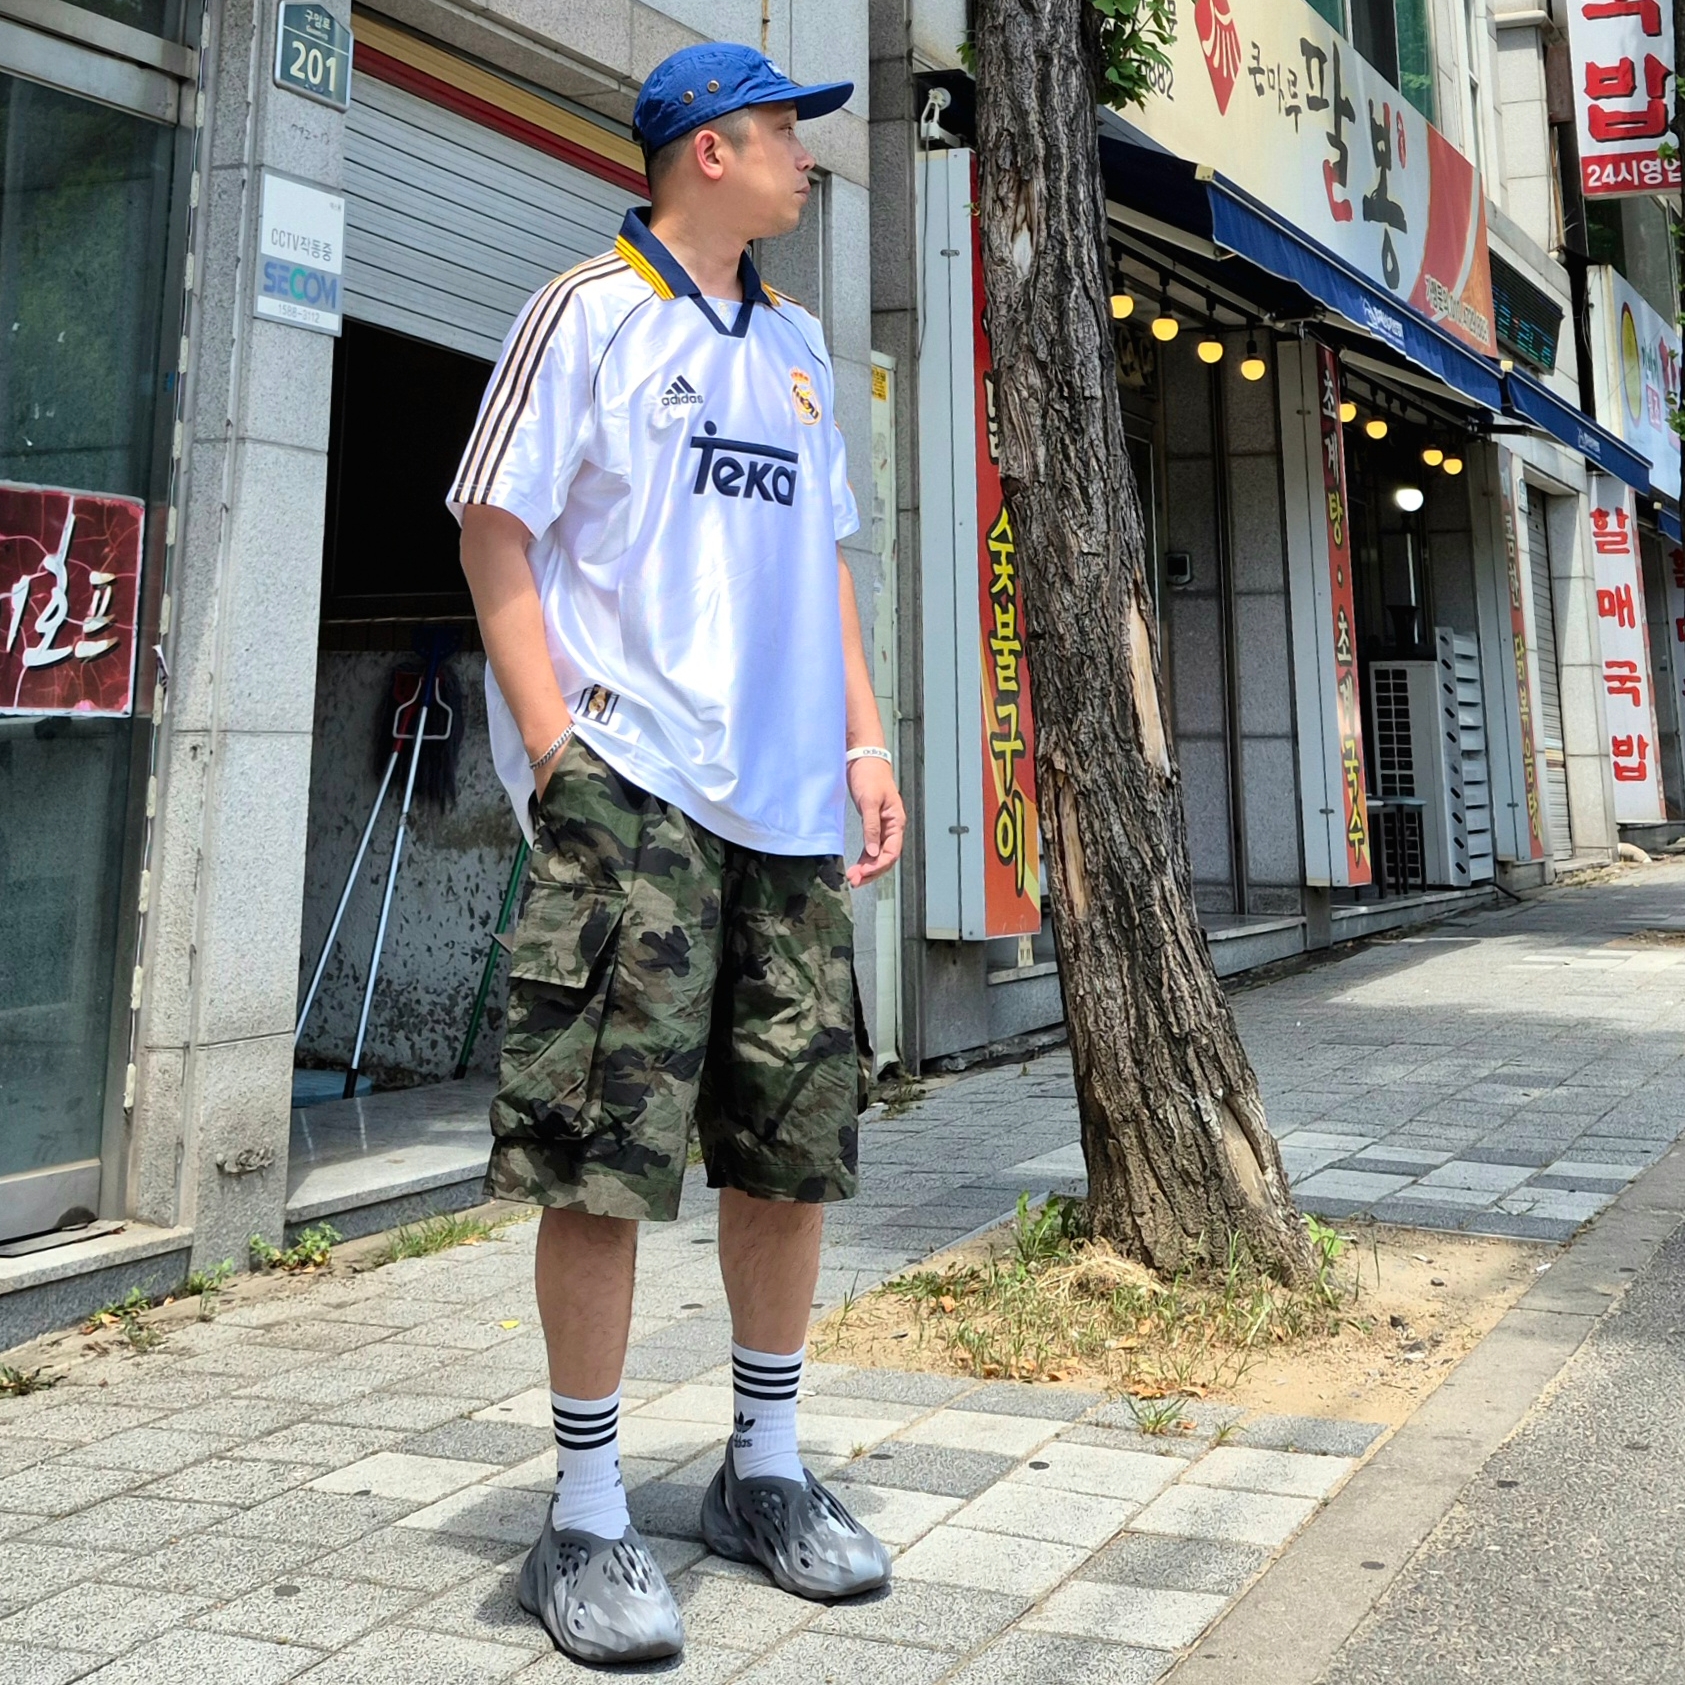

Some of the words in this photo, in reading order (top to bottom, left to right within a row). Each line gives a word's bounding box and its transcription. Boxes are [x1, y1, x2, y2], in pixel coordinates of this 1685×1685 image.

[290, 41, 336, 92] 201
[271, 228, 332, 262] CCTV작동중
[263, 261, 337, 309] SECOM
[278, 303, 320, 324] 1588-3112
[661, 393, 704, 407] adidas
[1589, 506, 1650, 783] 할매국밥
[986, 504, 1026, 892] 숯불구이
